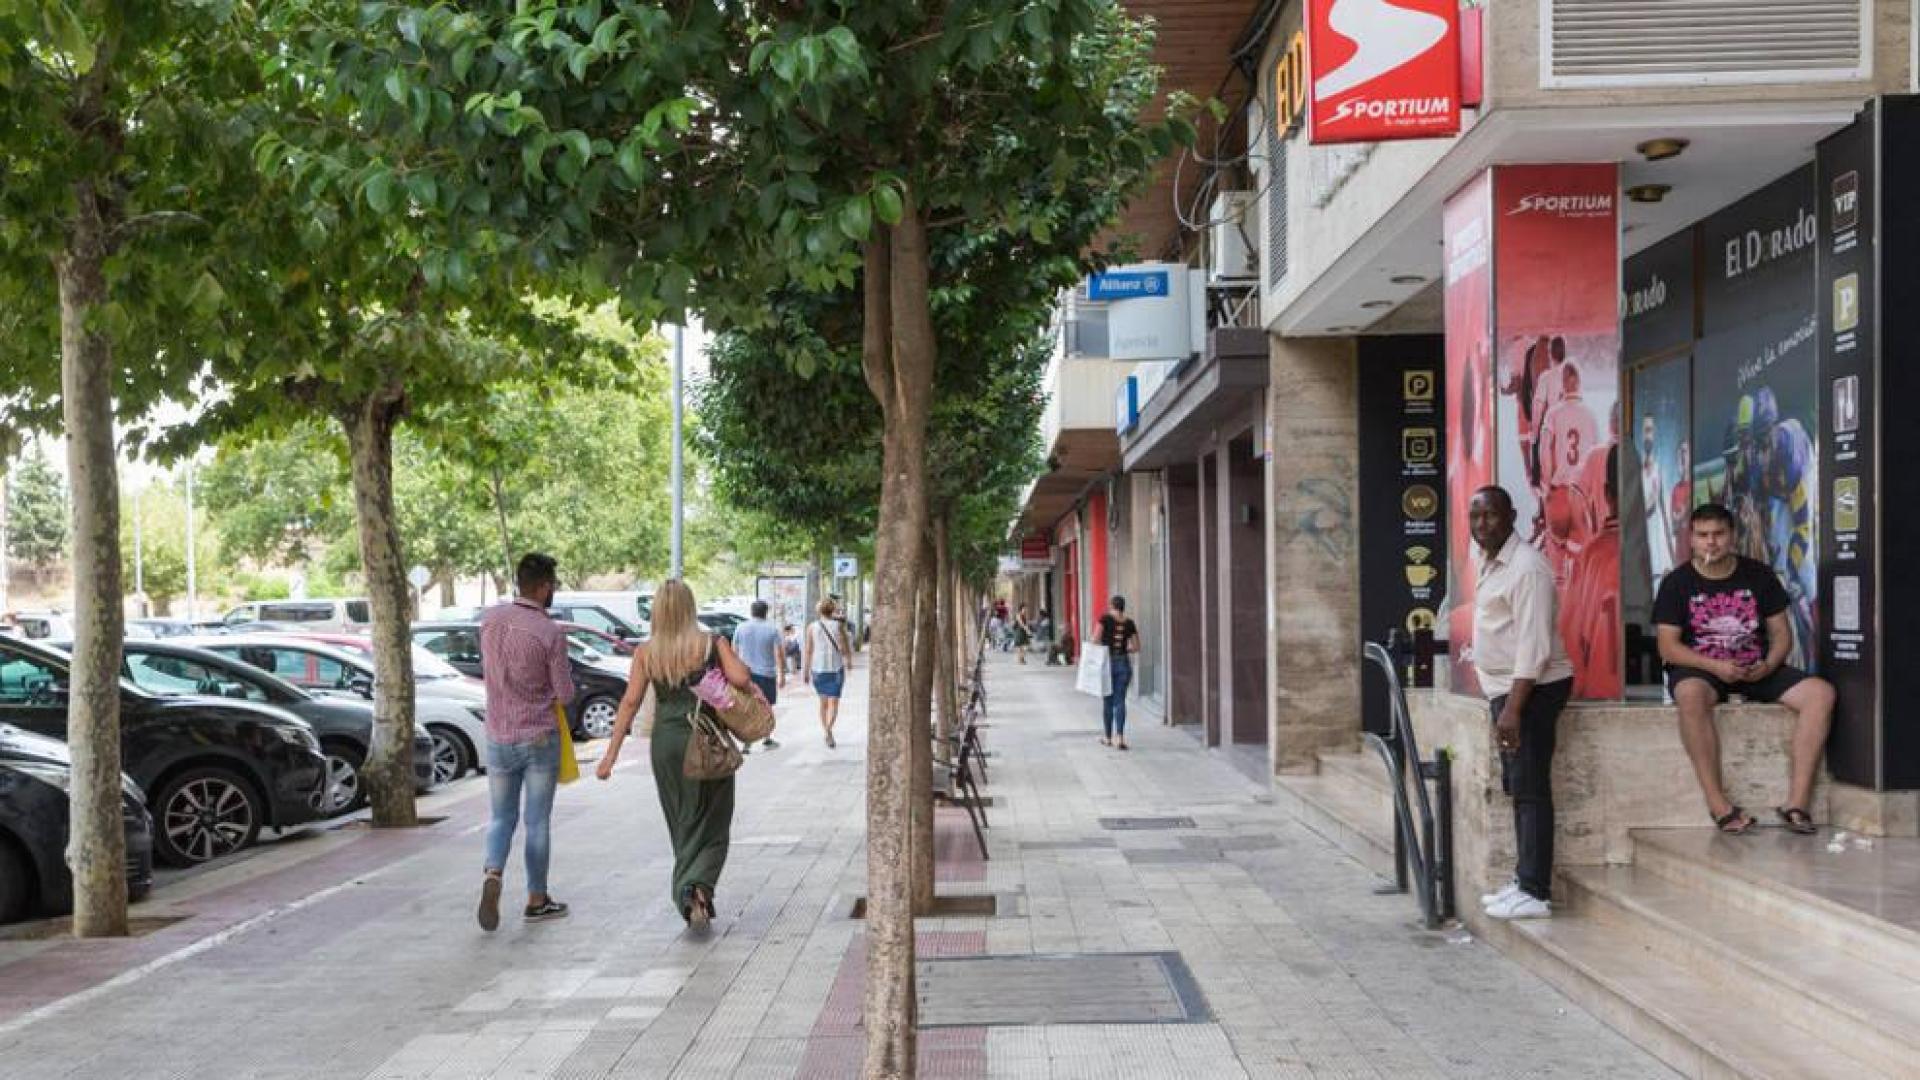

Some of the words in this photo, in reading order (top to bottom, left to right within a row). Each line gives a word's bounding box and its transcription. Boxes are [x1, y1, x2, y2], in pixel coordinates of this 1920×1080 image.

[1320, 97, 1449, 125] SPORTIUM
[1505, 192, 1612, 216] SPORTIUM
[1834, 191, 1857, 214] VIP
[1099, 278, 1141, 291] Allianz
[1566, 429, 1580, 467] 3
